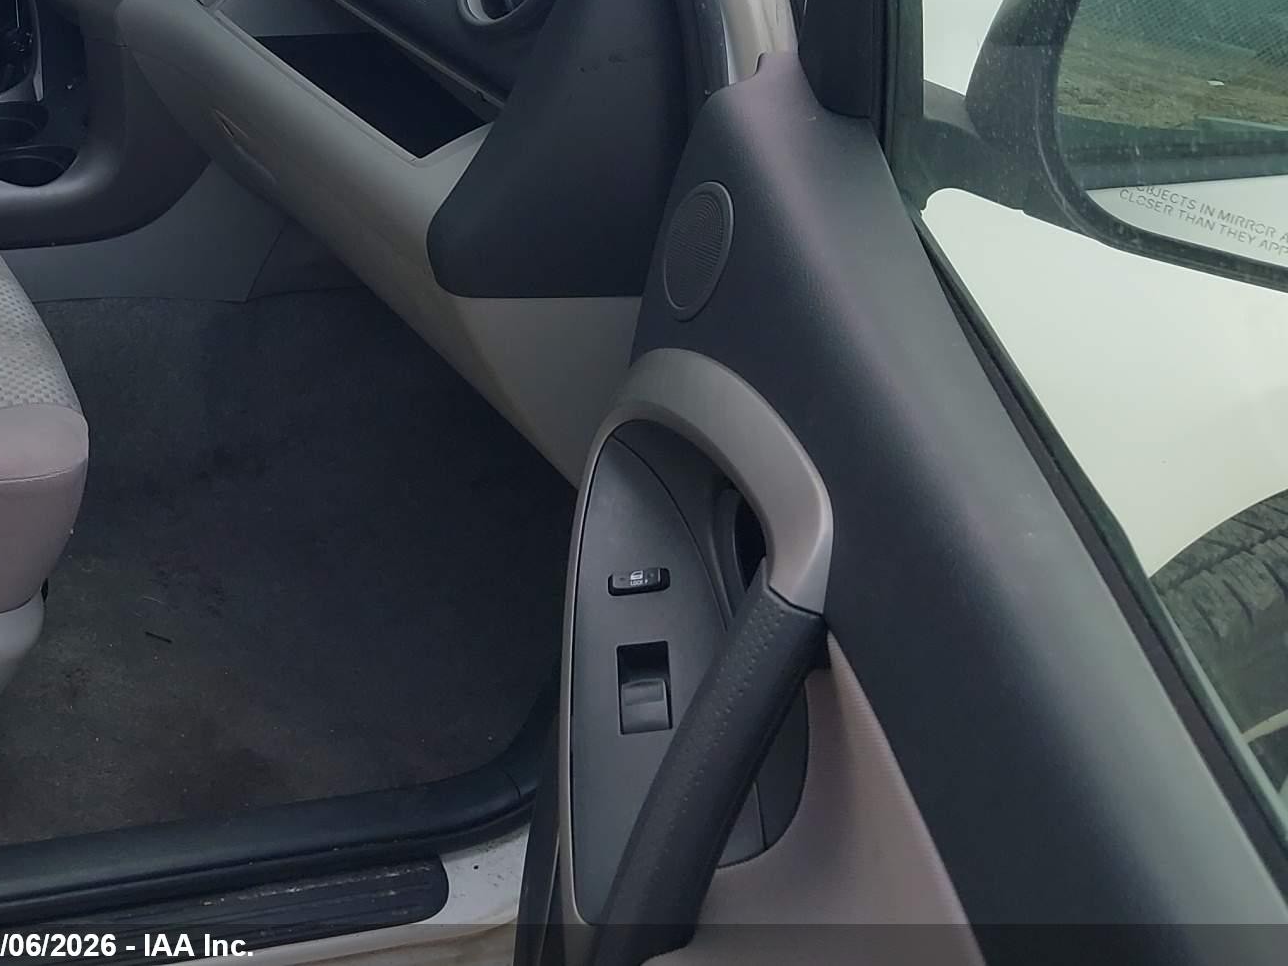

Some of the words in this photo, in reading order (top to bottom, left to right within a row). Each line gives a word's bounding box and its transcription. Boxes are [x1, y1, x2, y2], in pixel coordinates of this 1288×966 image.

[1119, 188, 1174, 217] CLOSER
[1178, 209, 1216, 231] THAN
[1220, 224, 1257, 245] THEY
[1199, 203, 1216, 217] IN
[1217, 209, 1277, 239] MIRROR
